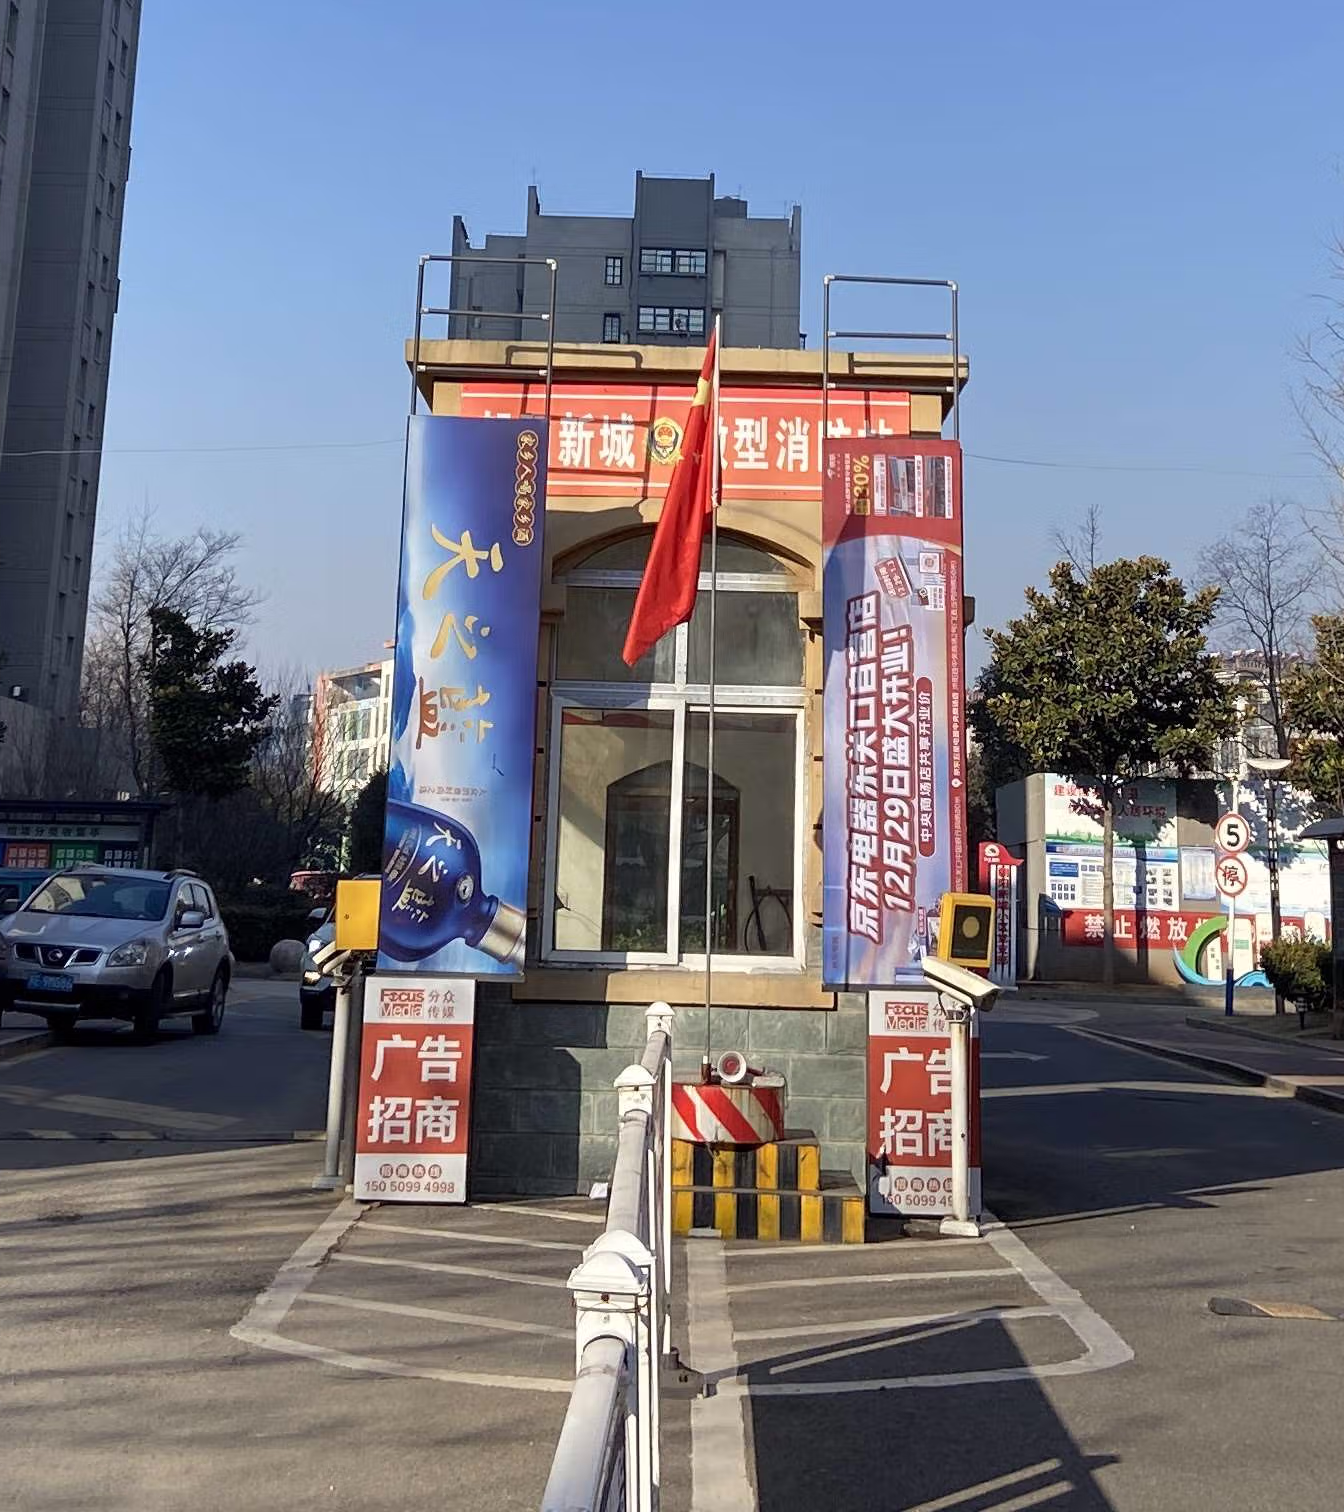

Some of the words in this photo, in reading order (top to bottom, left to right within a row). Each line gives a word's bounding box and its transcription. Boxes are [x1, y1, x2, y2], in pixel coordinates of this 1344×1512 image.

[514, 432, 537, 543] 家乡人喝家乡酒
[848, 594, 880, 940] 京东电器东关口自营店
[919, 690, 933, 843] 中央商场店共享开业价
[1227, 824, 1240, 847] 5
[381, 989, 424, 1003] Focus
[428, 990, 455, 1004] 分众
[381, 1003, 423, 1017] Media
[428, 1005, 455, 1019] 传媒
[885, 1002, 928, 1016] Focus
[886, 1016, 928, 1031] Media
[371, 1034, 463, 1083] 广告
[367, 1096, 461, 1144] 招商
[365, 1181, 387, 1192] 150
[390, 1181, 421, 1193] 5099
[423, 1181, 455, 1194] 4998
[905, 1194, 936, 1206] 5099
